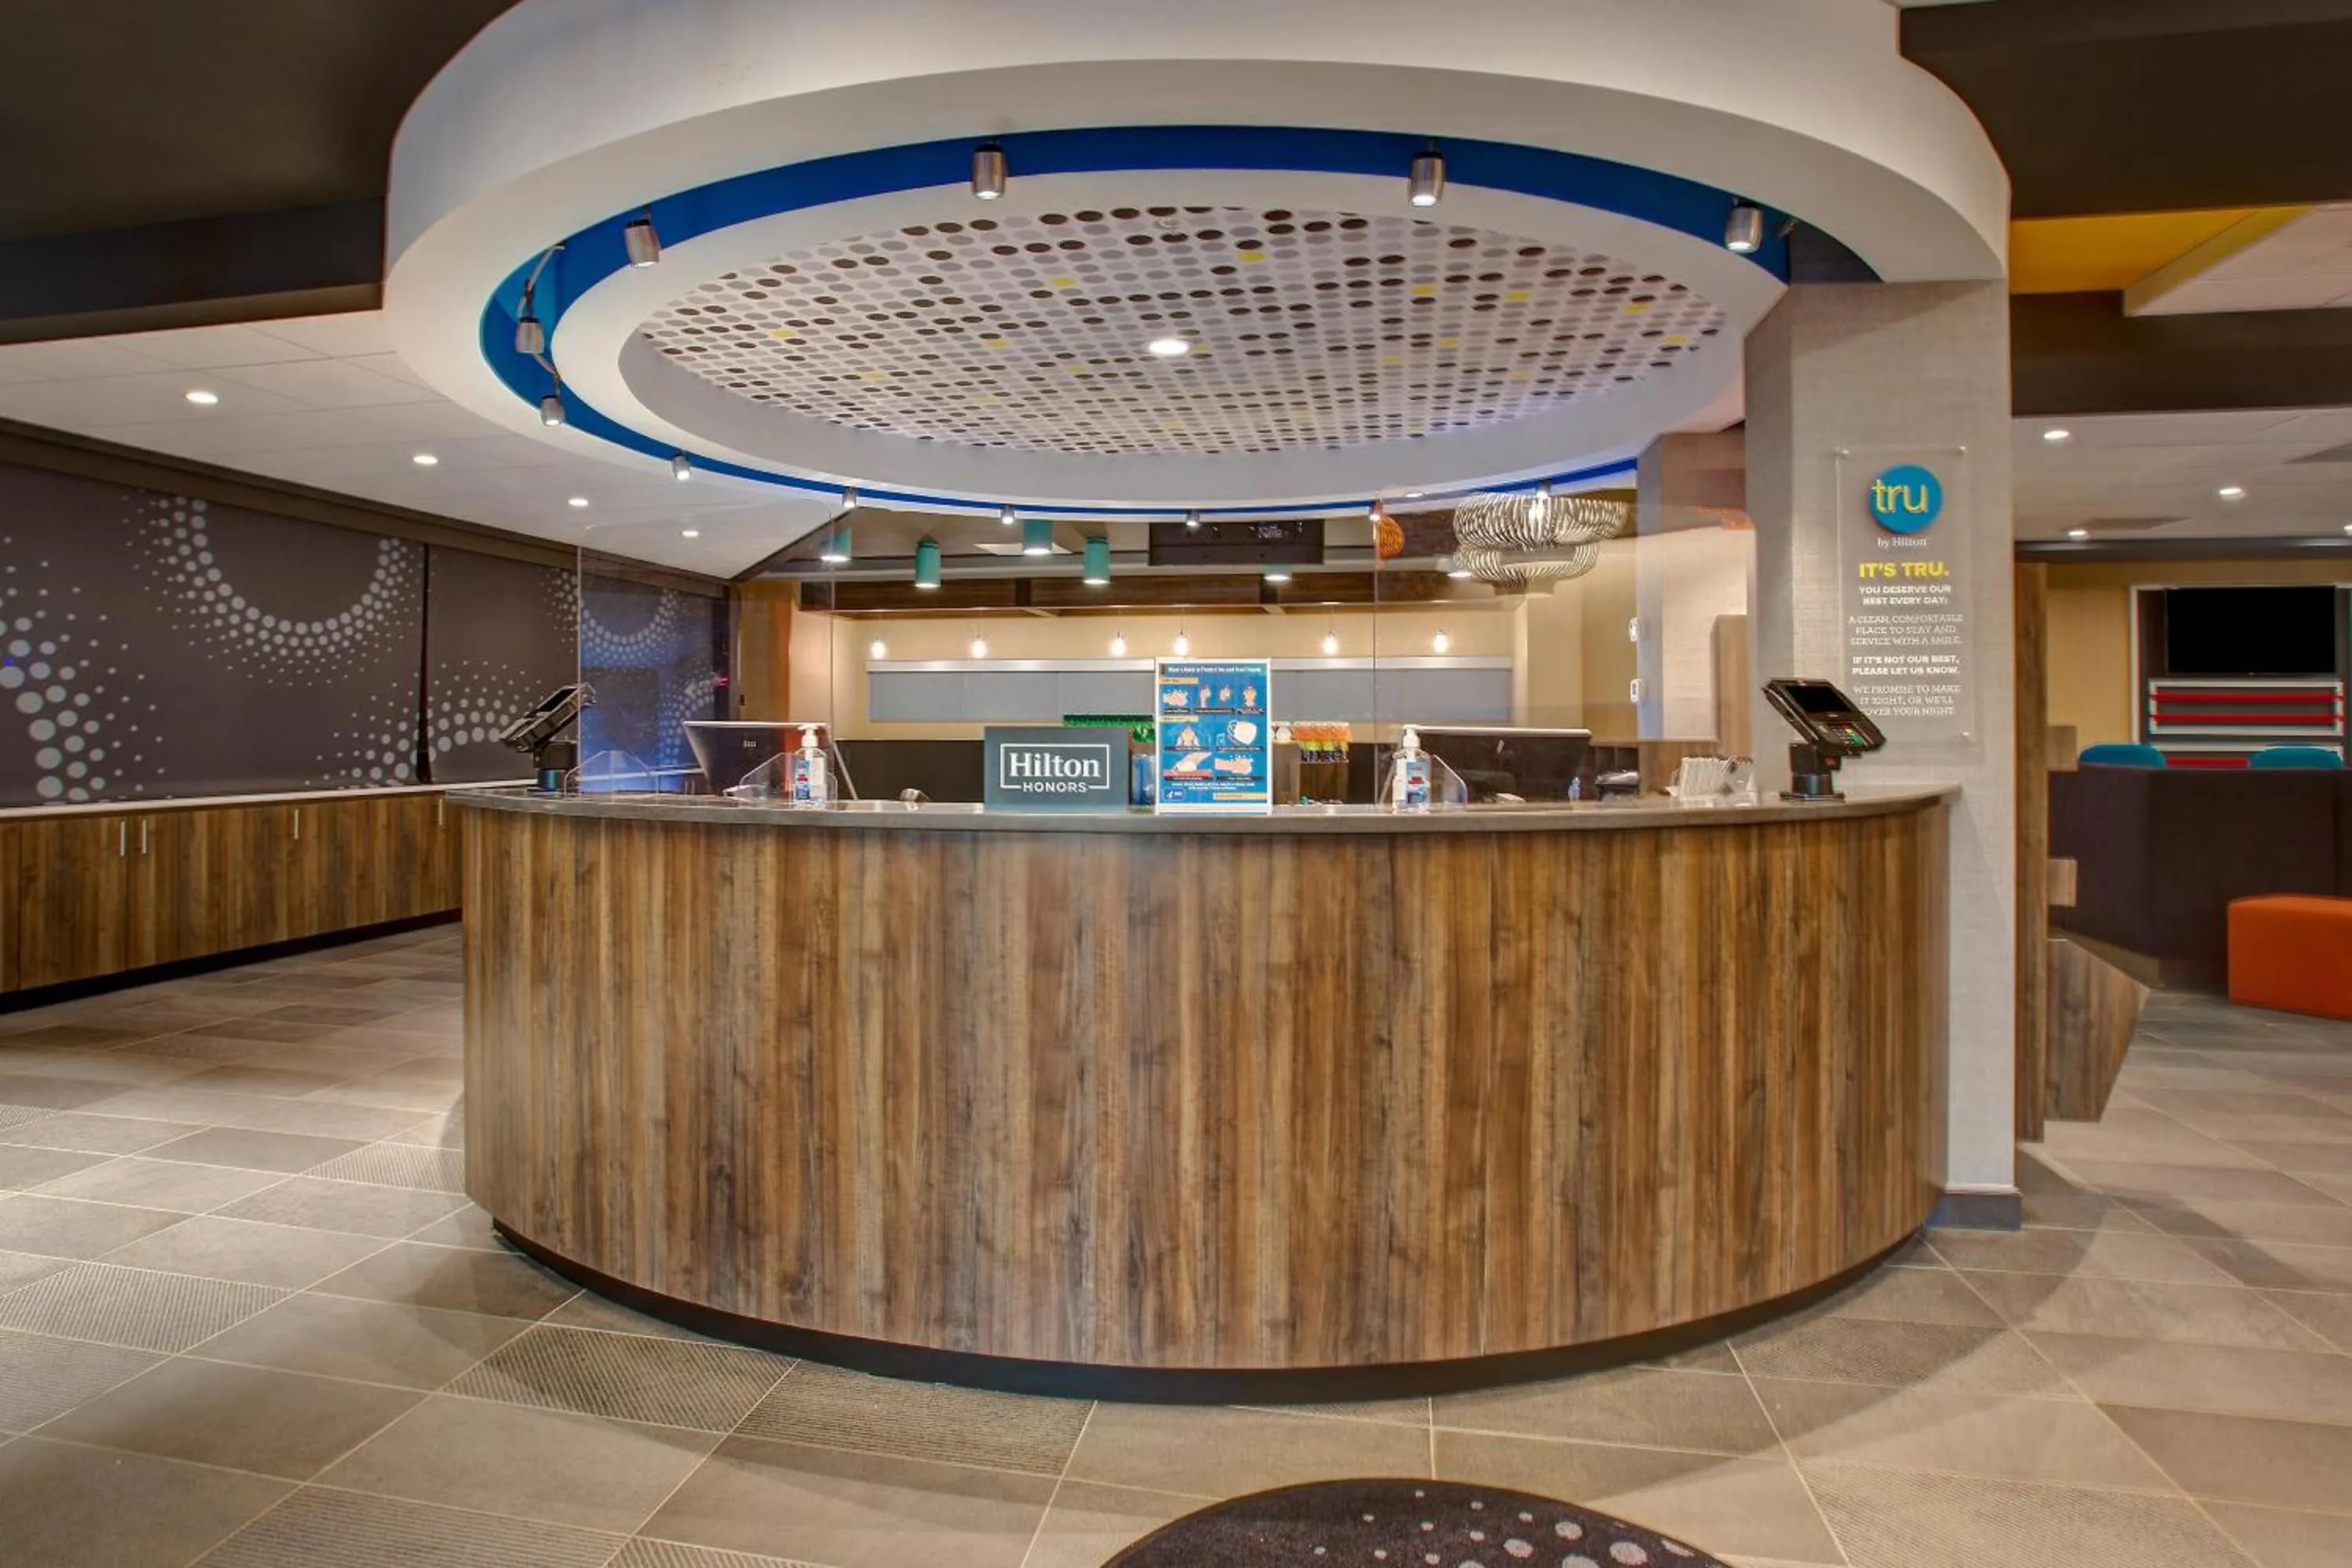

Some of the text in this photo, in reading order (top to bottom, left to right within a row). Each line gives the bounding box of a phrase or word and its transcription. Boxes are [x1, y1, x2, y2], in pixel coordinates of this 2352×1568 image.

[1871, 479, 1929, 514] tru
[1877, 537, 1926, 549] by Hilton
[1859, 561, 1951, 578] IT'S TRU.
[1859, 584, 1951, 594] YOU DESERVE OUR
[1863, 597, 1888, 605] BEST
[1889, 596, 1921, 604] EVERY
[1849, 615, 1857, 625] A
[1892, 614, 1964, 624] COMFORTABLE
[1906, 626, 1931, 634] STAY
[1933, 625, 1957, 633] AND
[1849, 637, 1891, 645] SERVICE
[1892, 637, 1920, 645] WITH
[1853, 655, 1862, 664] IF
[1864, 655, 1882, 664] IT'S
[1884, 655, 1905, 664] NOT
[1906, 655, 1929, 663] OUR
[1911, 666, 1924, 675] US
[1854, 684, 1962, 694] WE PROMISE TO MAKE
[1860, 696, 1870, 705] IT
[1907, 696, 1922, 705] OR
[1893, 707, 1922, 716] YOUR
[1009, 752, 1101, 778] Hilton
[1022, 782, 1087, 793] HONORS
